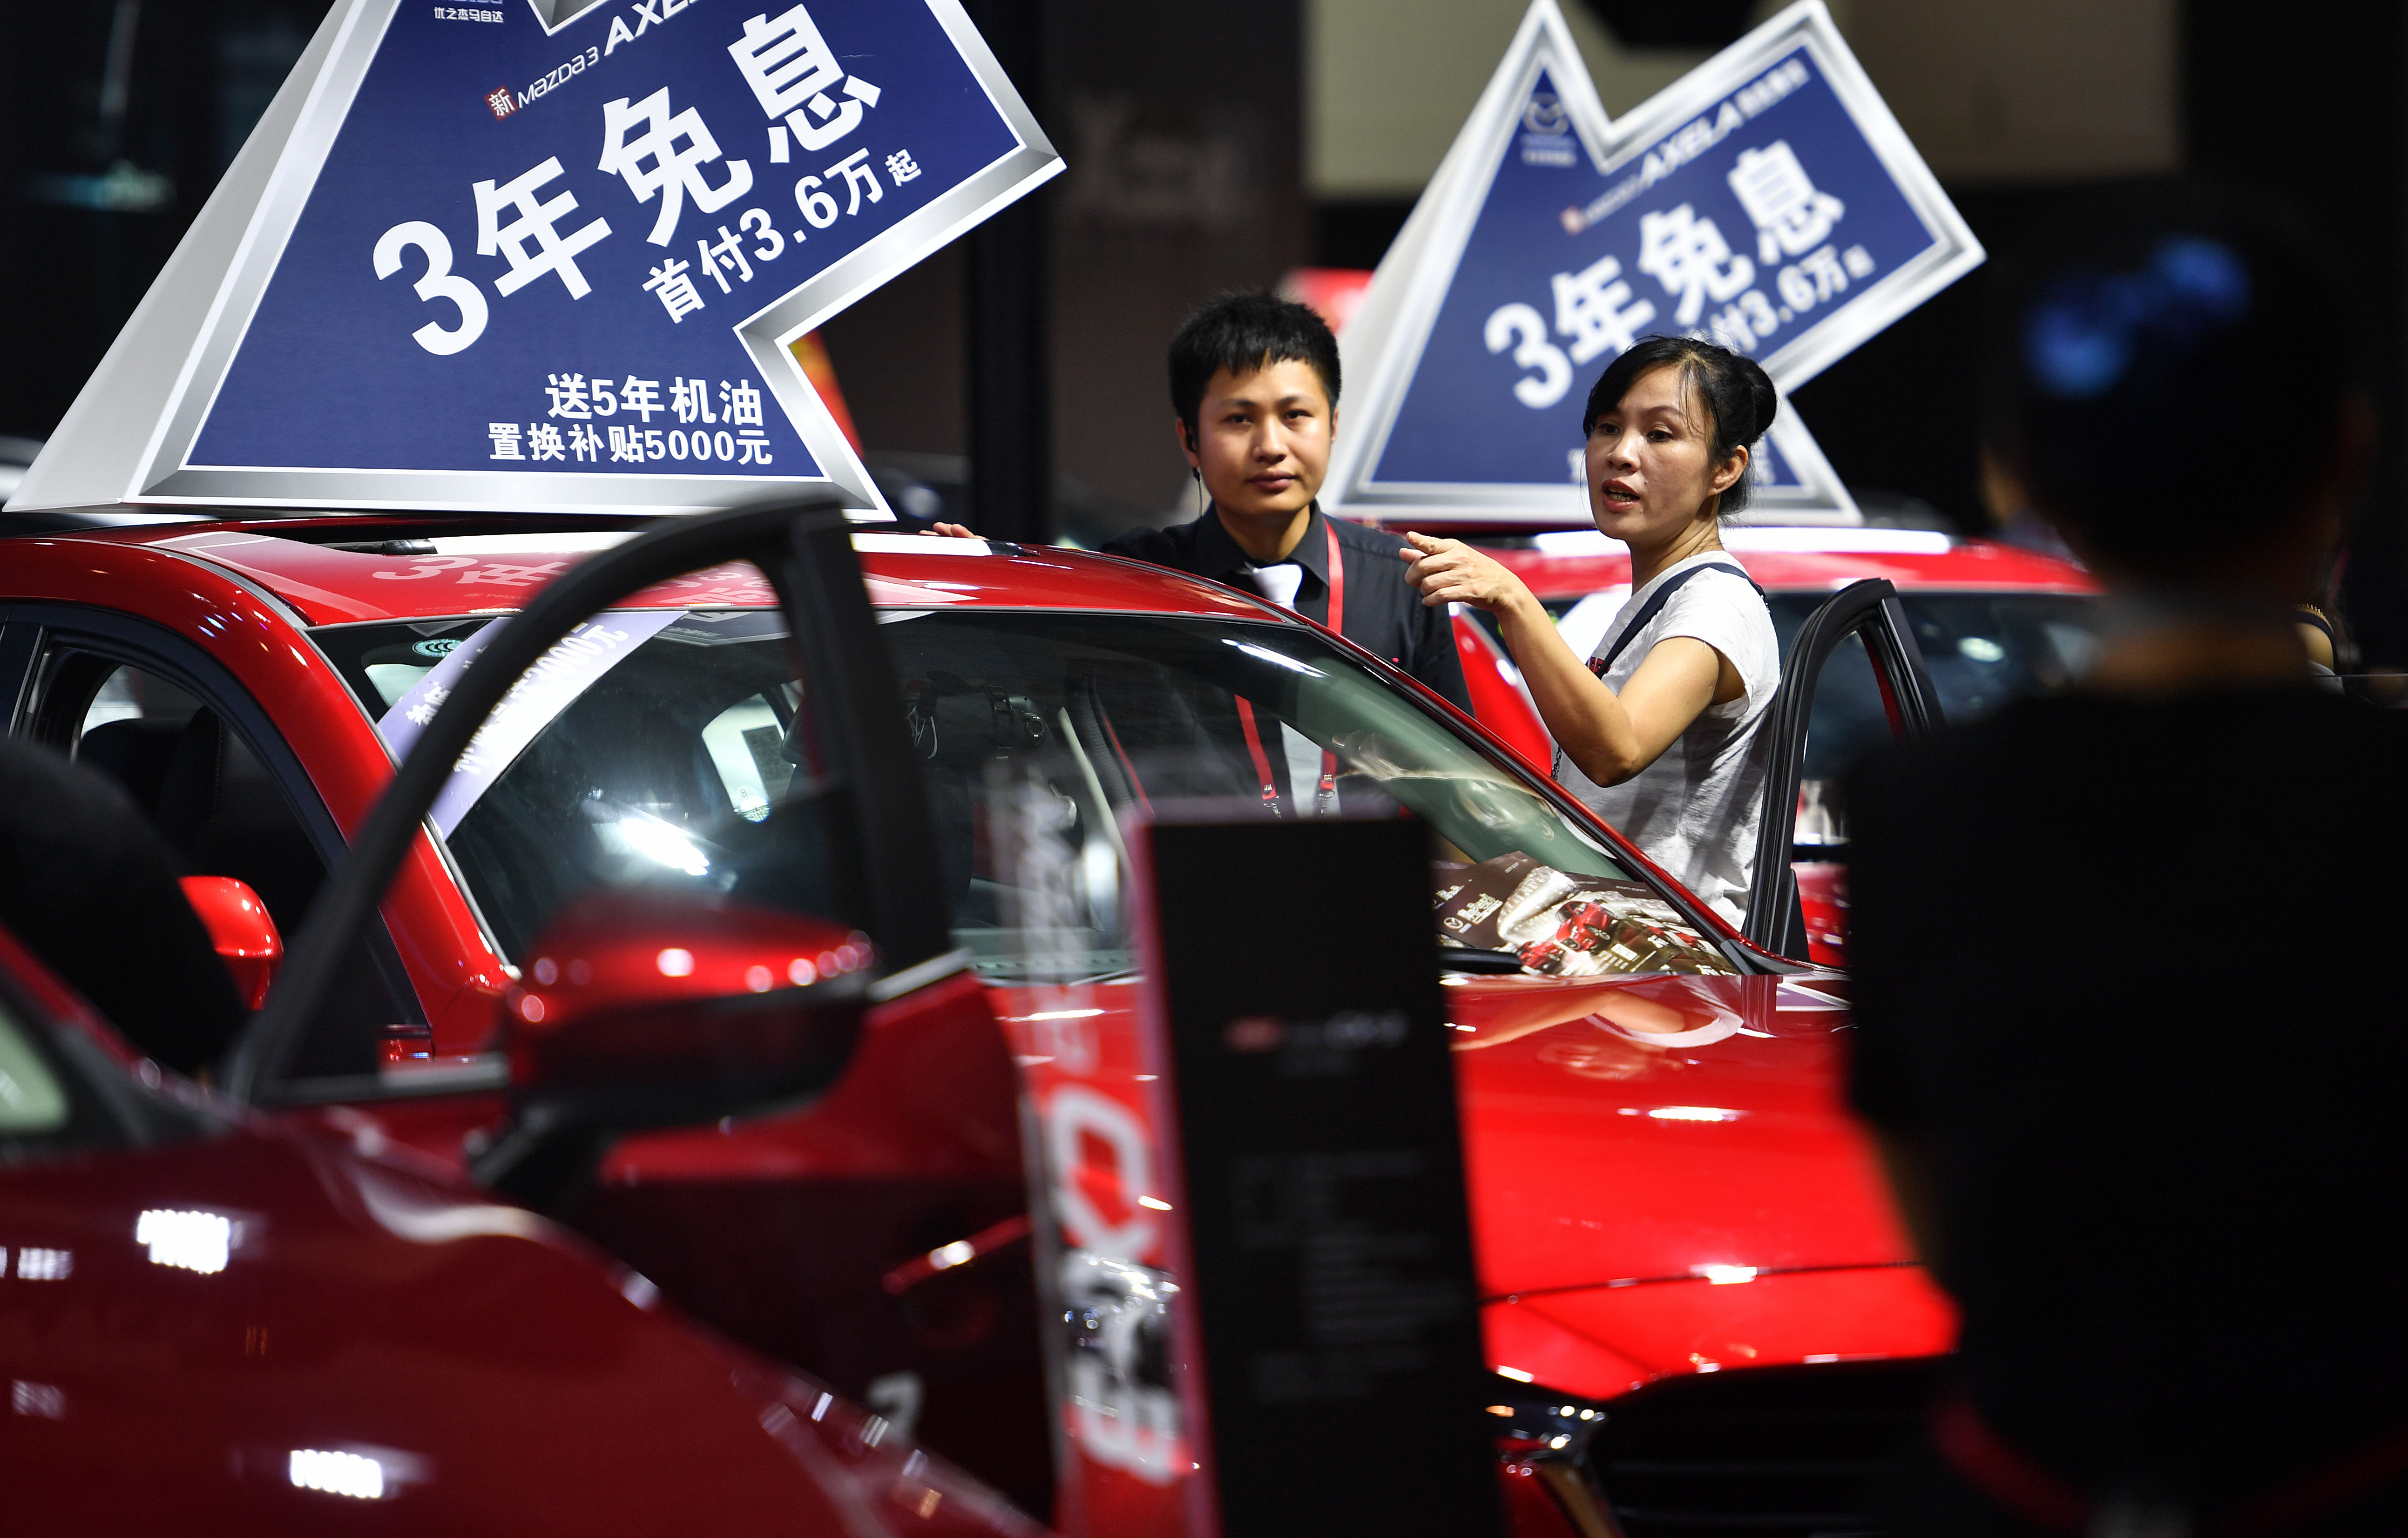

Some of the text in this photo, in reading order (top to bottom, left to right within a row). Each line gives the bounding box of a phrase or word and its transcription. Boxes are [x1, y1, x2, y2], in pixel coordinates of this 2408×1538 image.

[434, 7, 504, 23] 优之杰马自达
[488, 88, 515, 117] 新
[372, 3, 881, 356] 3年免息
[1484, 139, 1846, 409] 3年免息
[545, 373, 764, 426] 送5年机油
[488, 423, 773, 465] 置换补贴5000元
